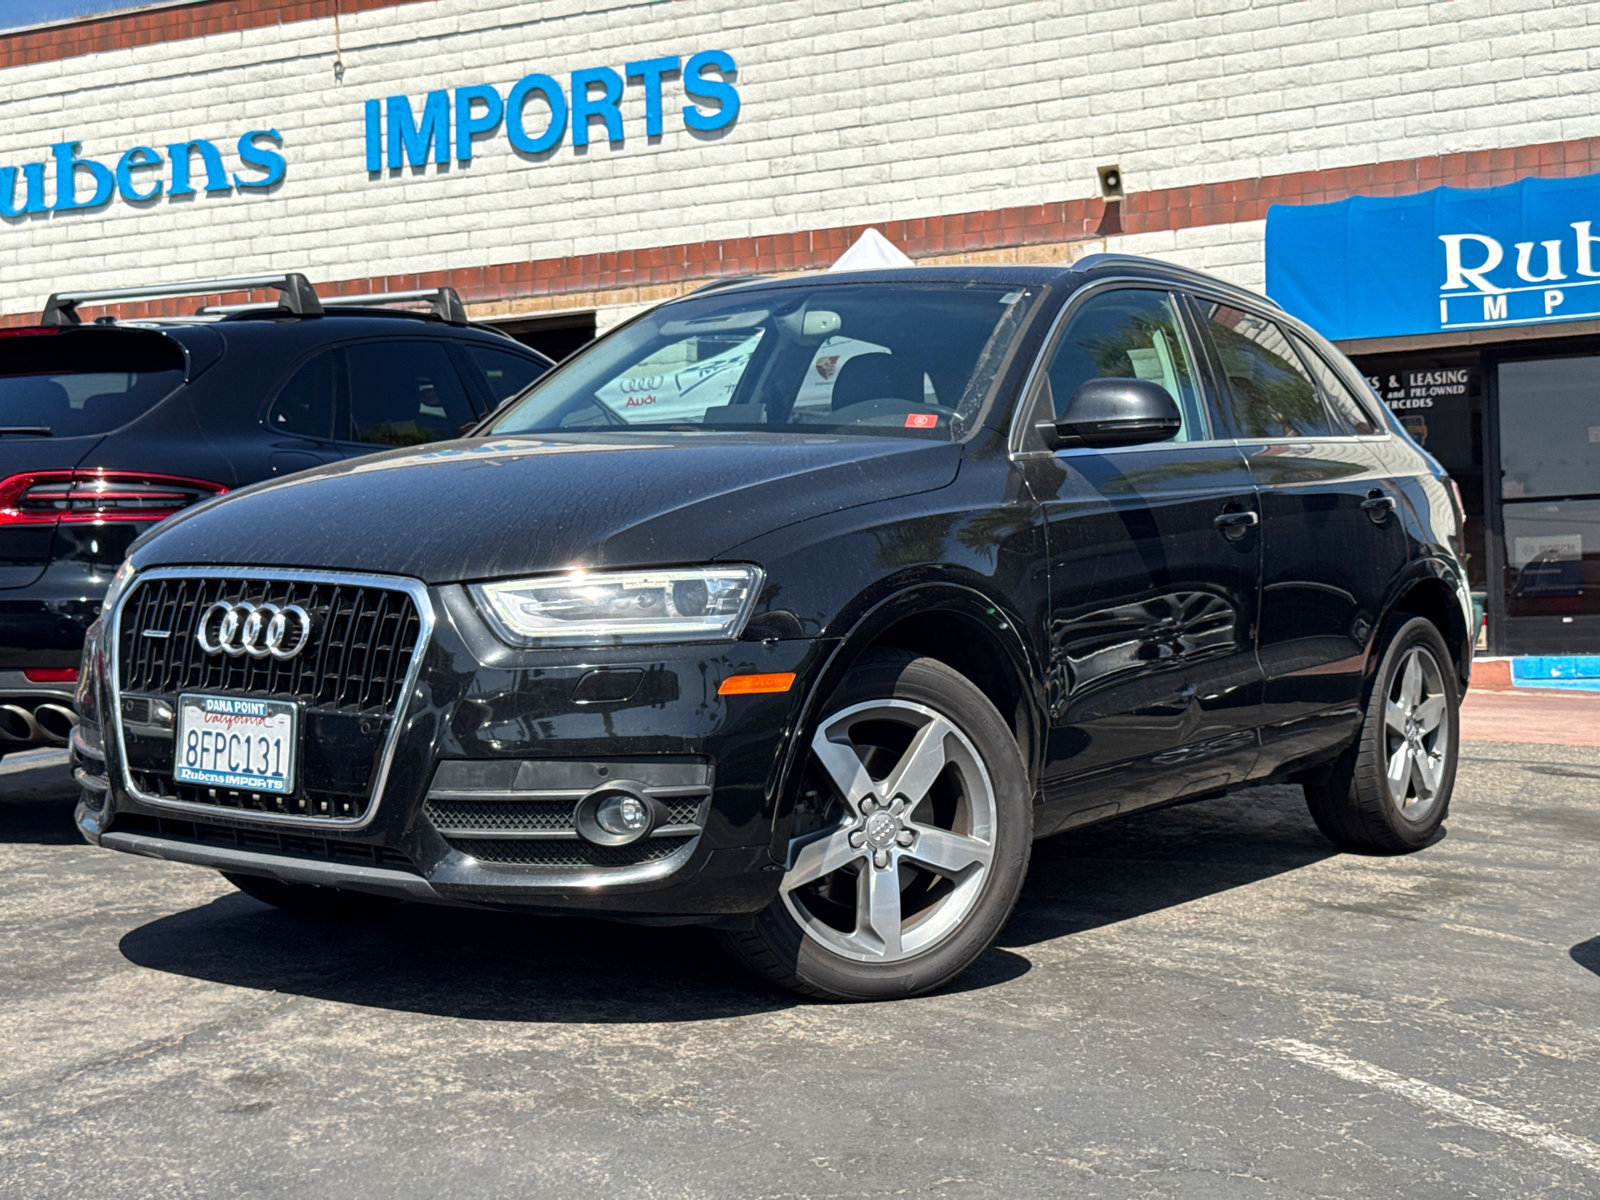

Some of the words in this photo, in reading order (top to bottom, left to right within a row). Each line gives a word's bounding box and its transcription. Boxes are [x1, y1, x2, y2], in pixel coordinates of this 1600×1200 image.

[365, 50, 741, 173] IMPORTS
[1388, 374, 1400, 389] &
[1409, 369, 1468, 387] LEASING
[626, 394, 657, 408] Audi
[1387, 389, 1405, 399] and
[1410, 385, 1465, 397] PRE-OWNED
[1385, 398, 1433, 410] ERCEDES
[206, 699, 233, 712] DANA
[234, 701, 265, 715] POINT
[186, 729, 284, 777] 8FPC131
[181, 768, 225, 783] Rubens
[225, 774, 283, 790] IMPORTS
